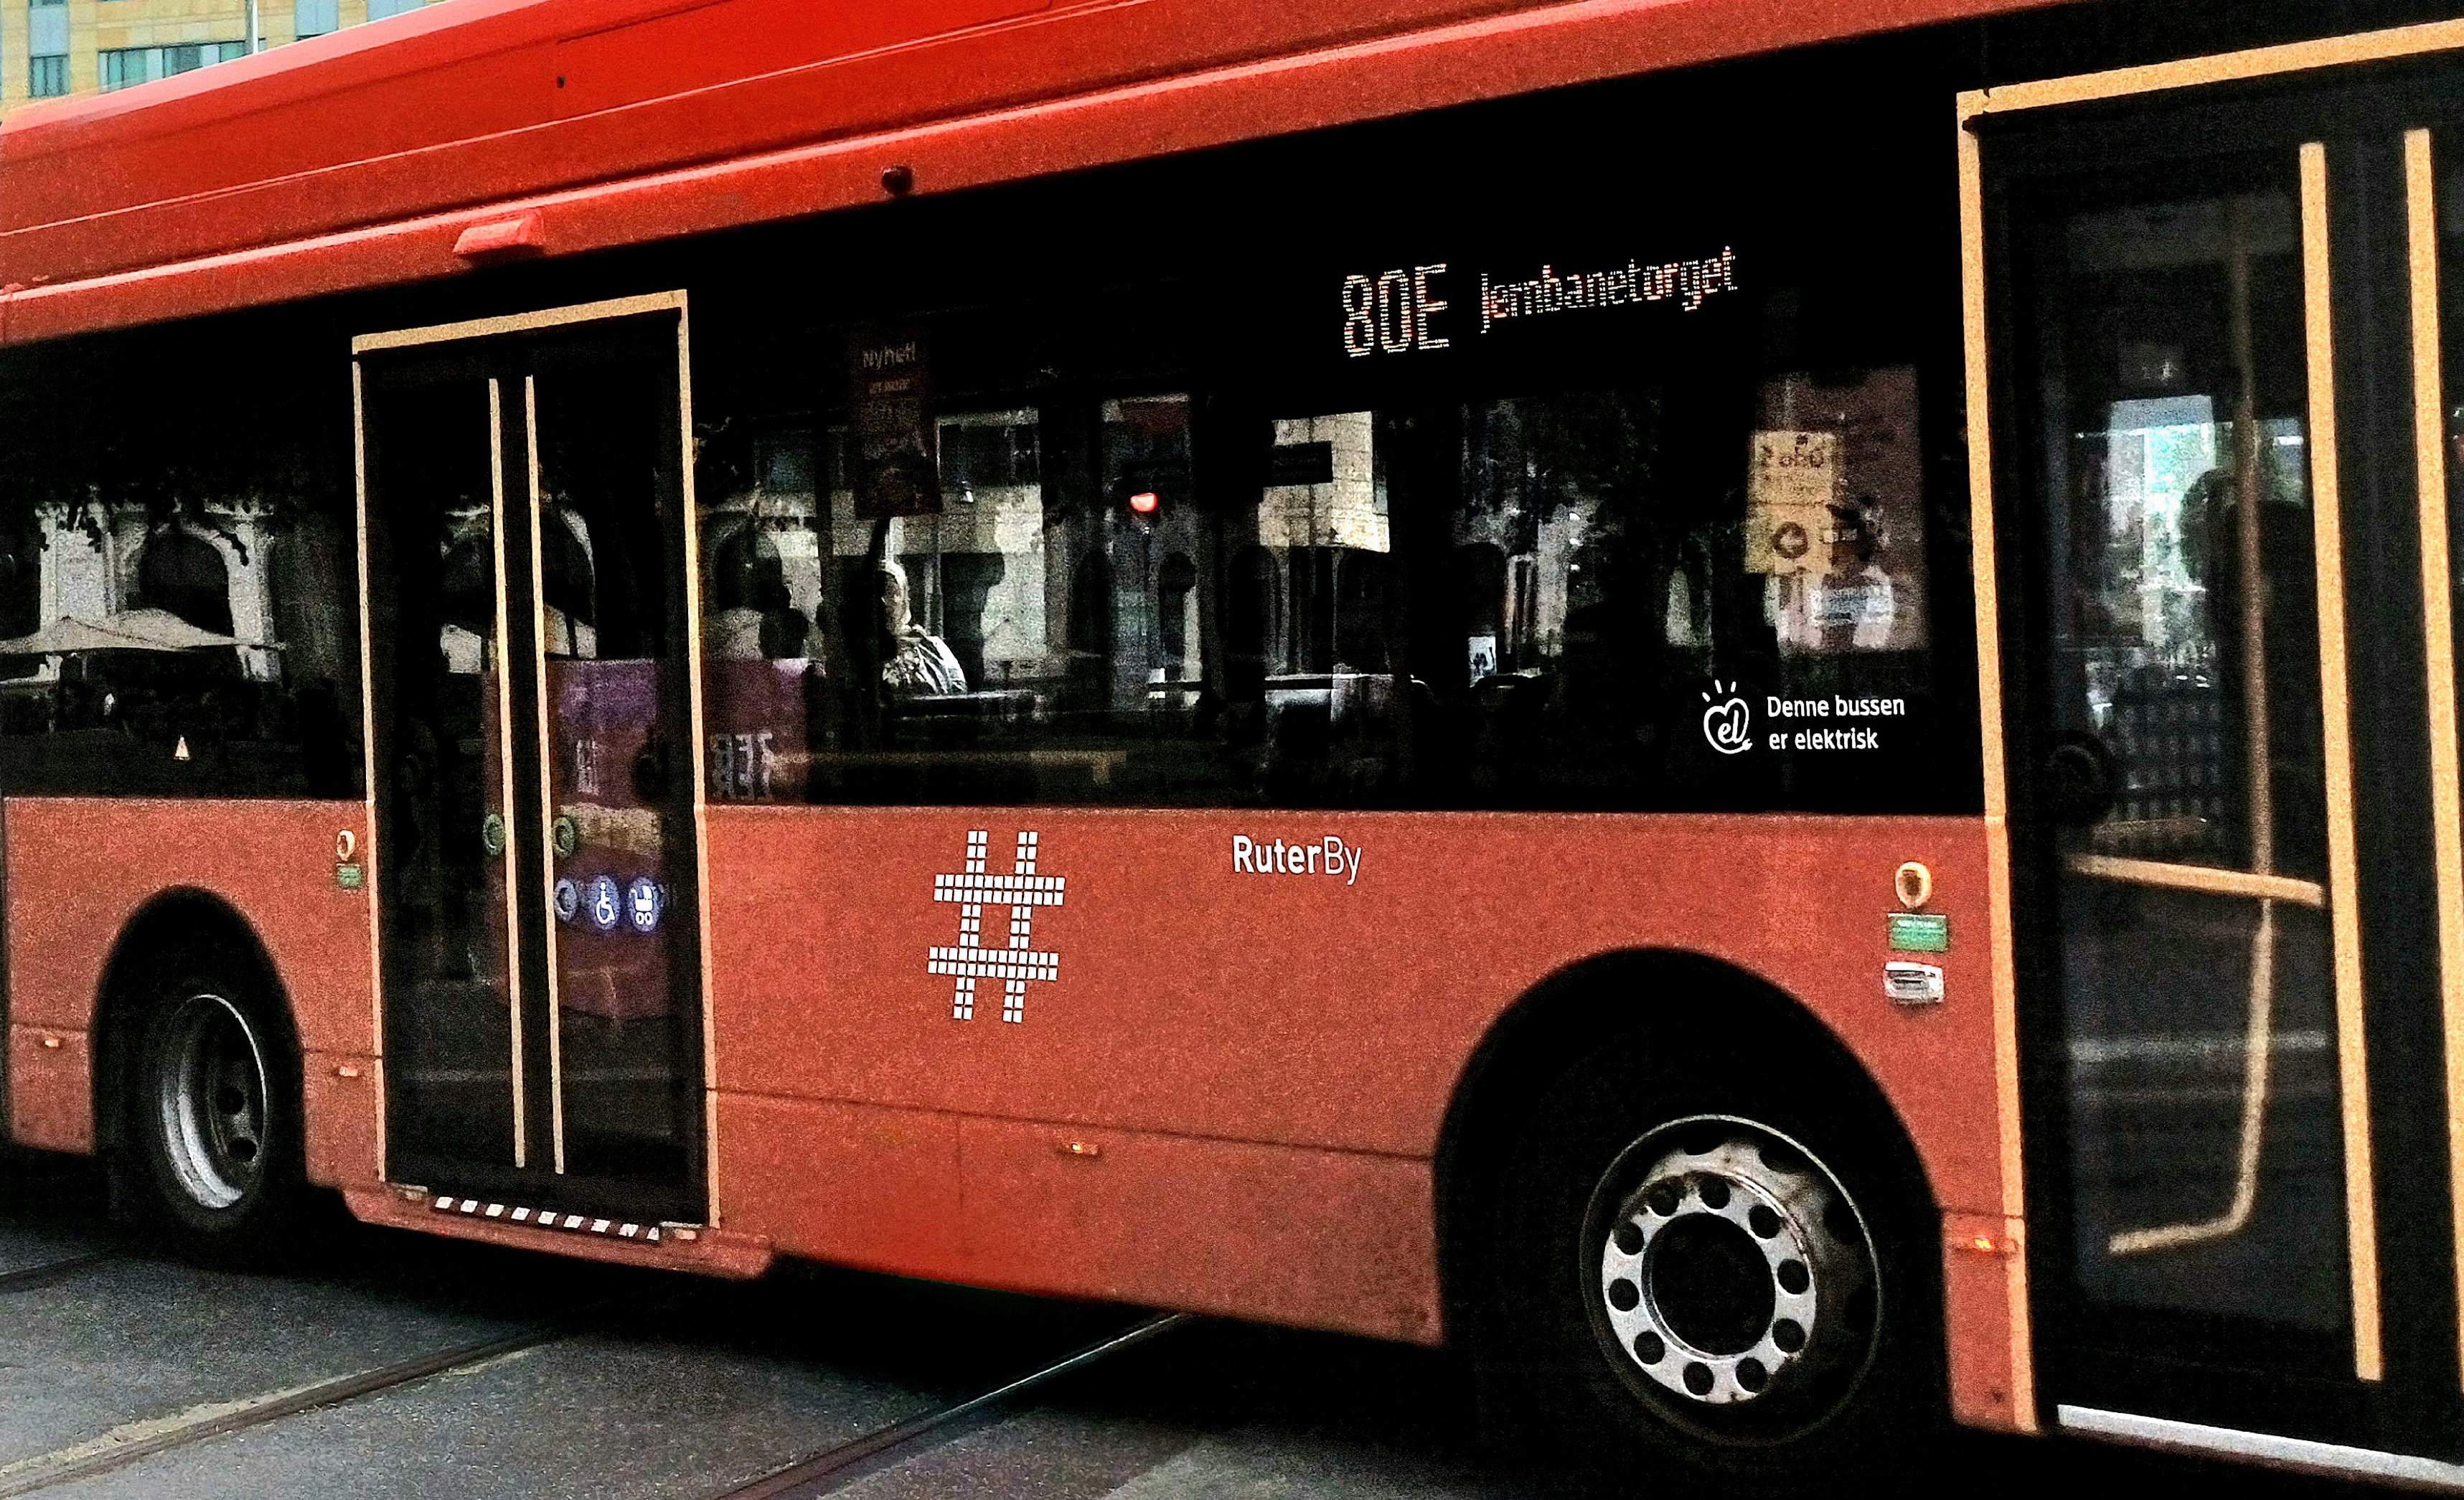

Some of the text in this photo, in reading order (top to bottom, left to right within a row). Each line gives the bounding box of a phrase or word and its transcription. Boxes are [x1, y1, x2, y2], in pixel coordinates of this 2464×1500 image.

[1342, 263, 1450, 358] 80E
[1767, 694, 1906, 718] Denne bussen
[1769, 727, 1879, 750] er elektrisk
[1233, 835, 1361, 886] RuterBy
